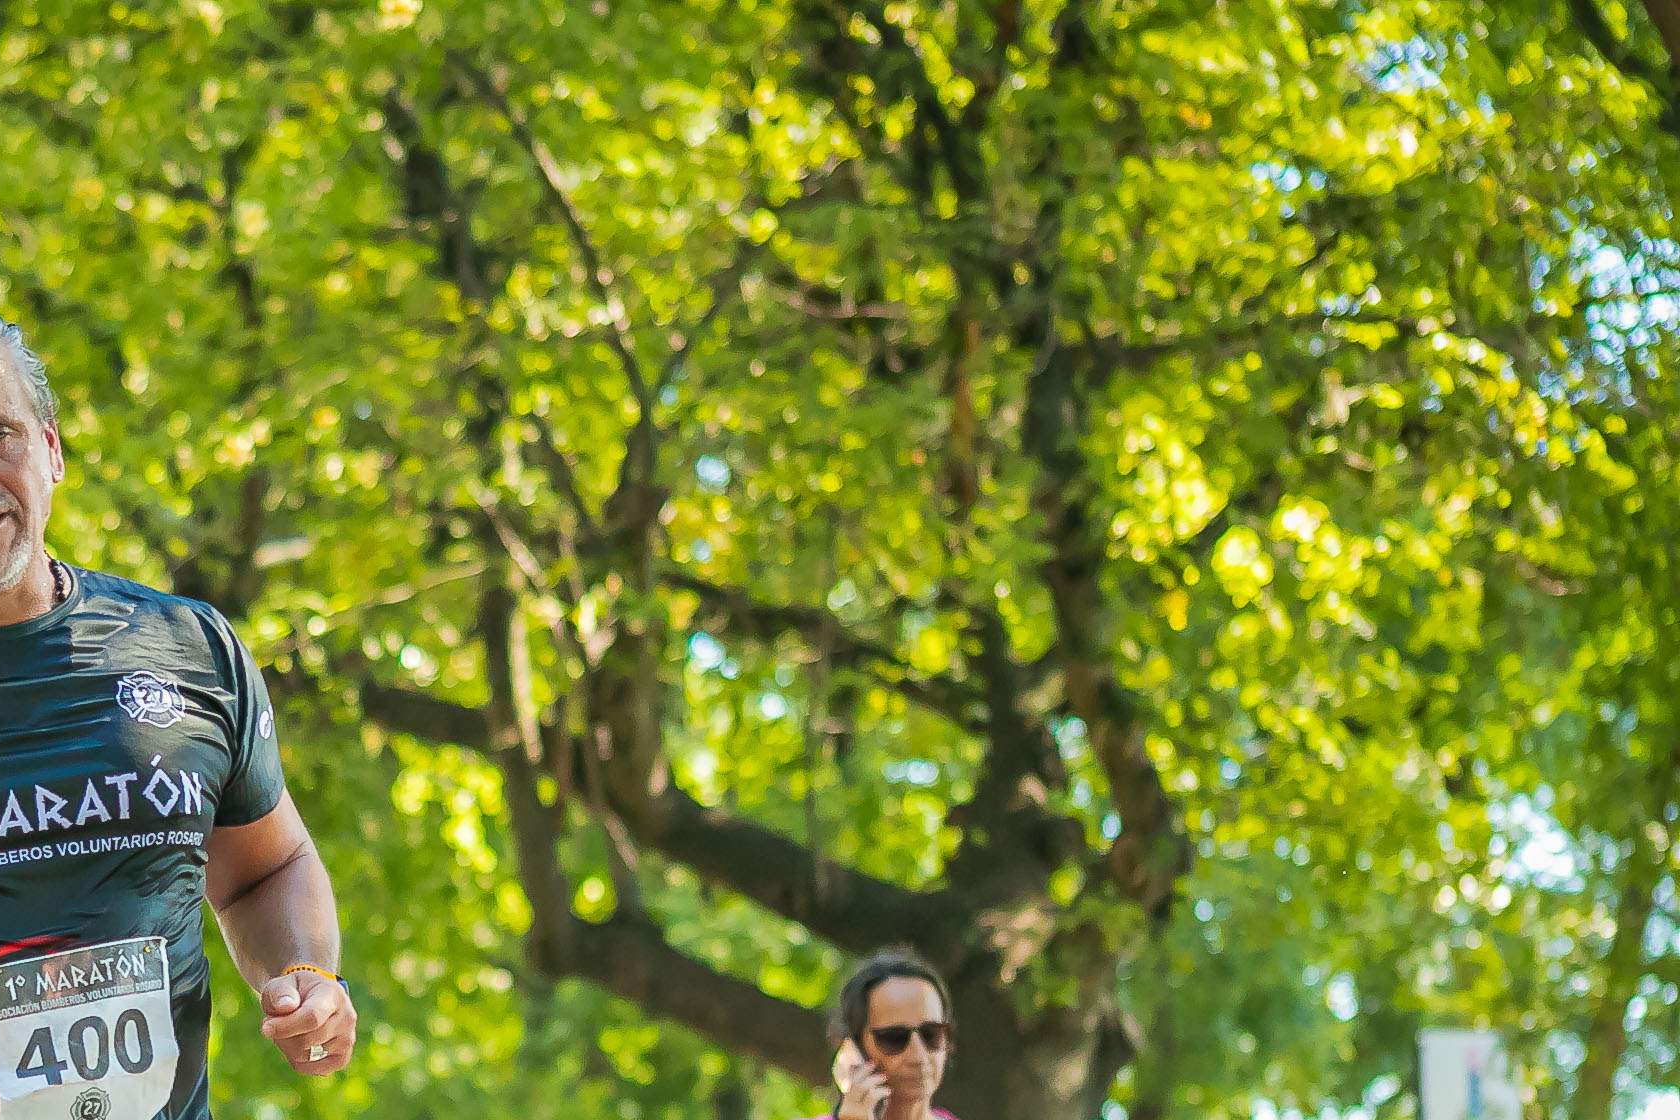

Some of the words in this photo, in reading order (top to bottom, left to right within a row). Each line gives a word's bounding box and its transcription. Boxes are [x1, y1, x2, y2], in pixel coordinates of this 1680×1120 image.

[55, 831, 165, 859] VOLUNTARIOS
[34, 949, 146, 996] MARATÓN
[15, 1008, 154, 1086] 400
[83, 1100, 101, 1116] 27
